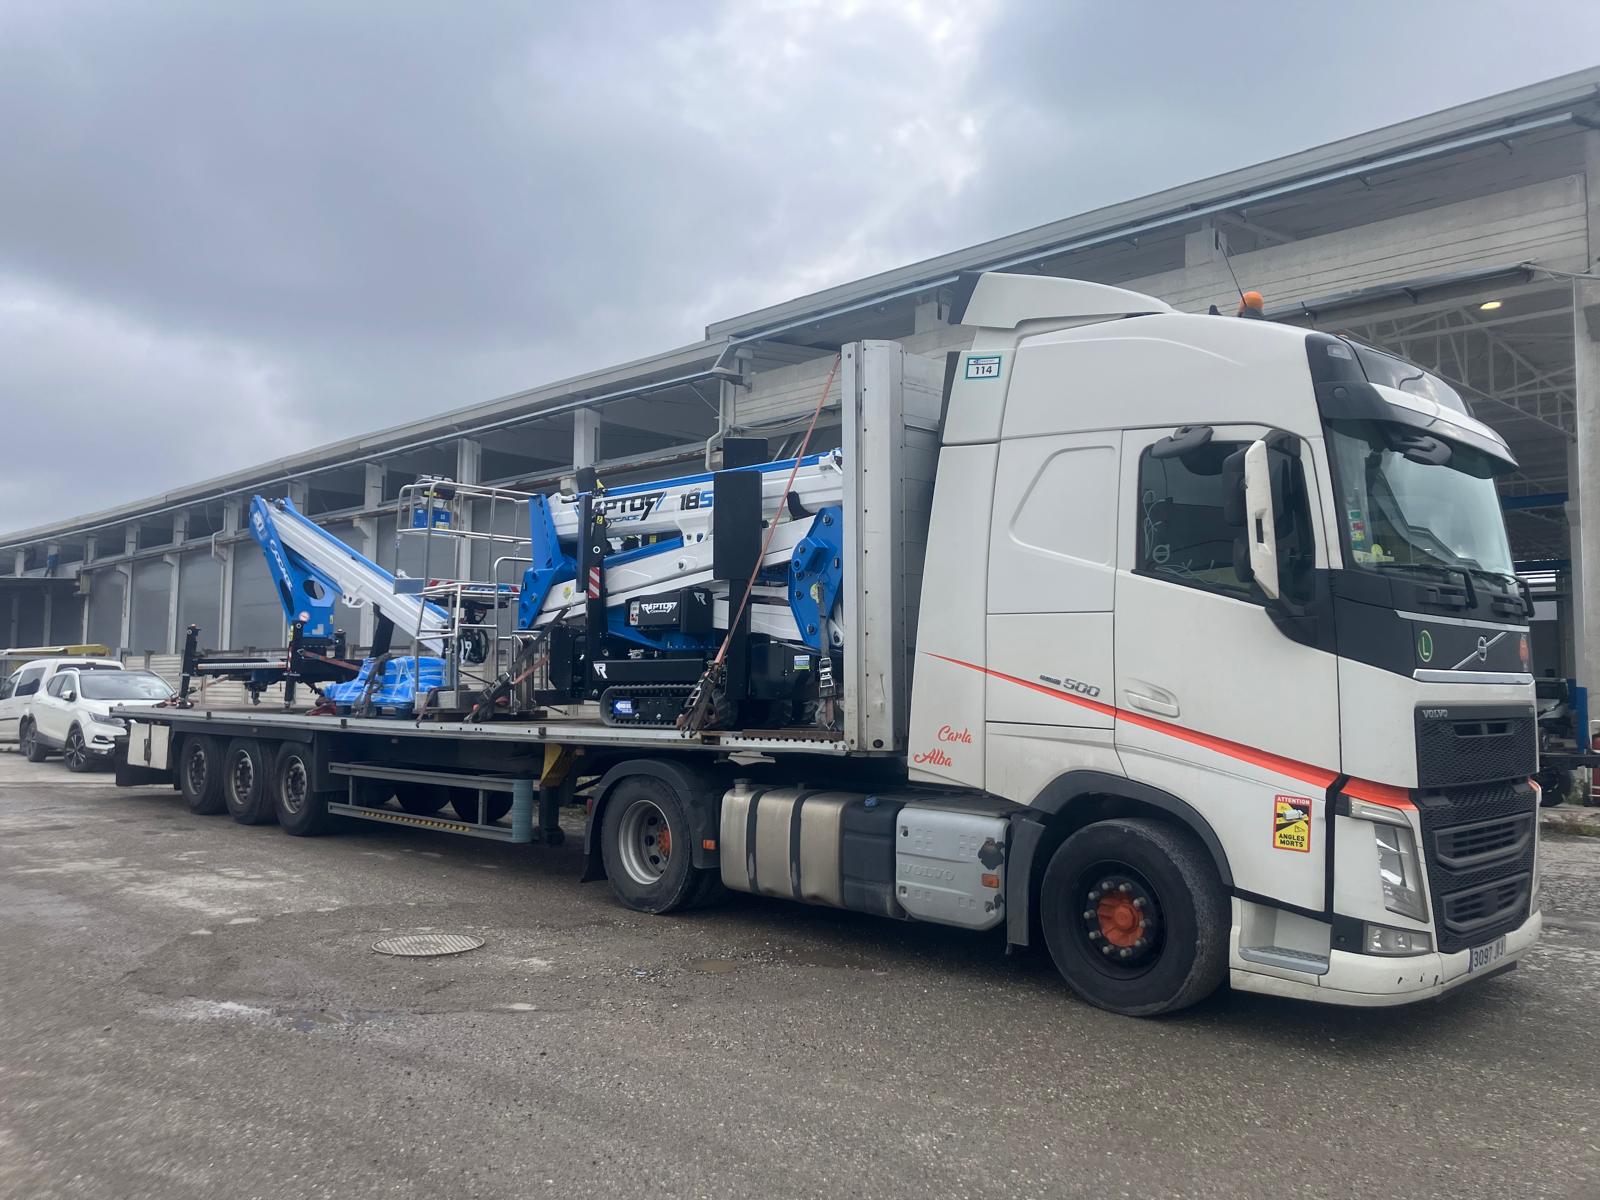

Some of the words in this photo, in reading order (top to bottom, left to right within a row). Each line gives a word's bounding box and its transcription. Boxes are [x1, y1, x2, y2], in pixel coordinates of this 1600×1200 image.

[976, 366, 992, 375] 114
[641, 602, 677, 614] RAPTOR
[1421, 636, 1430, 656] L
[594, 663, 608, 679] R
[1063, 678, 1100, 697] 500
[1422, 709, 1448, 719] VOLVO
[938, 725, 972, 744] Carla
[914, 748, 952, 767] Alba
[1277, 796, 1310, 805] ATTENTION
[1279, 833, 1305, 841] ANGLES
[1280, 839, 1304, 848] MORTS
[1474, 946, 1493, 967] 3097
